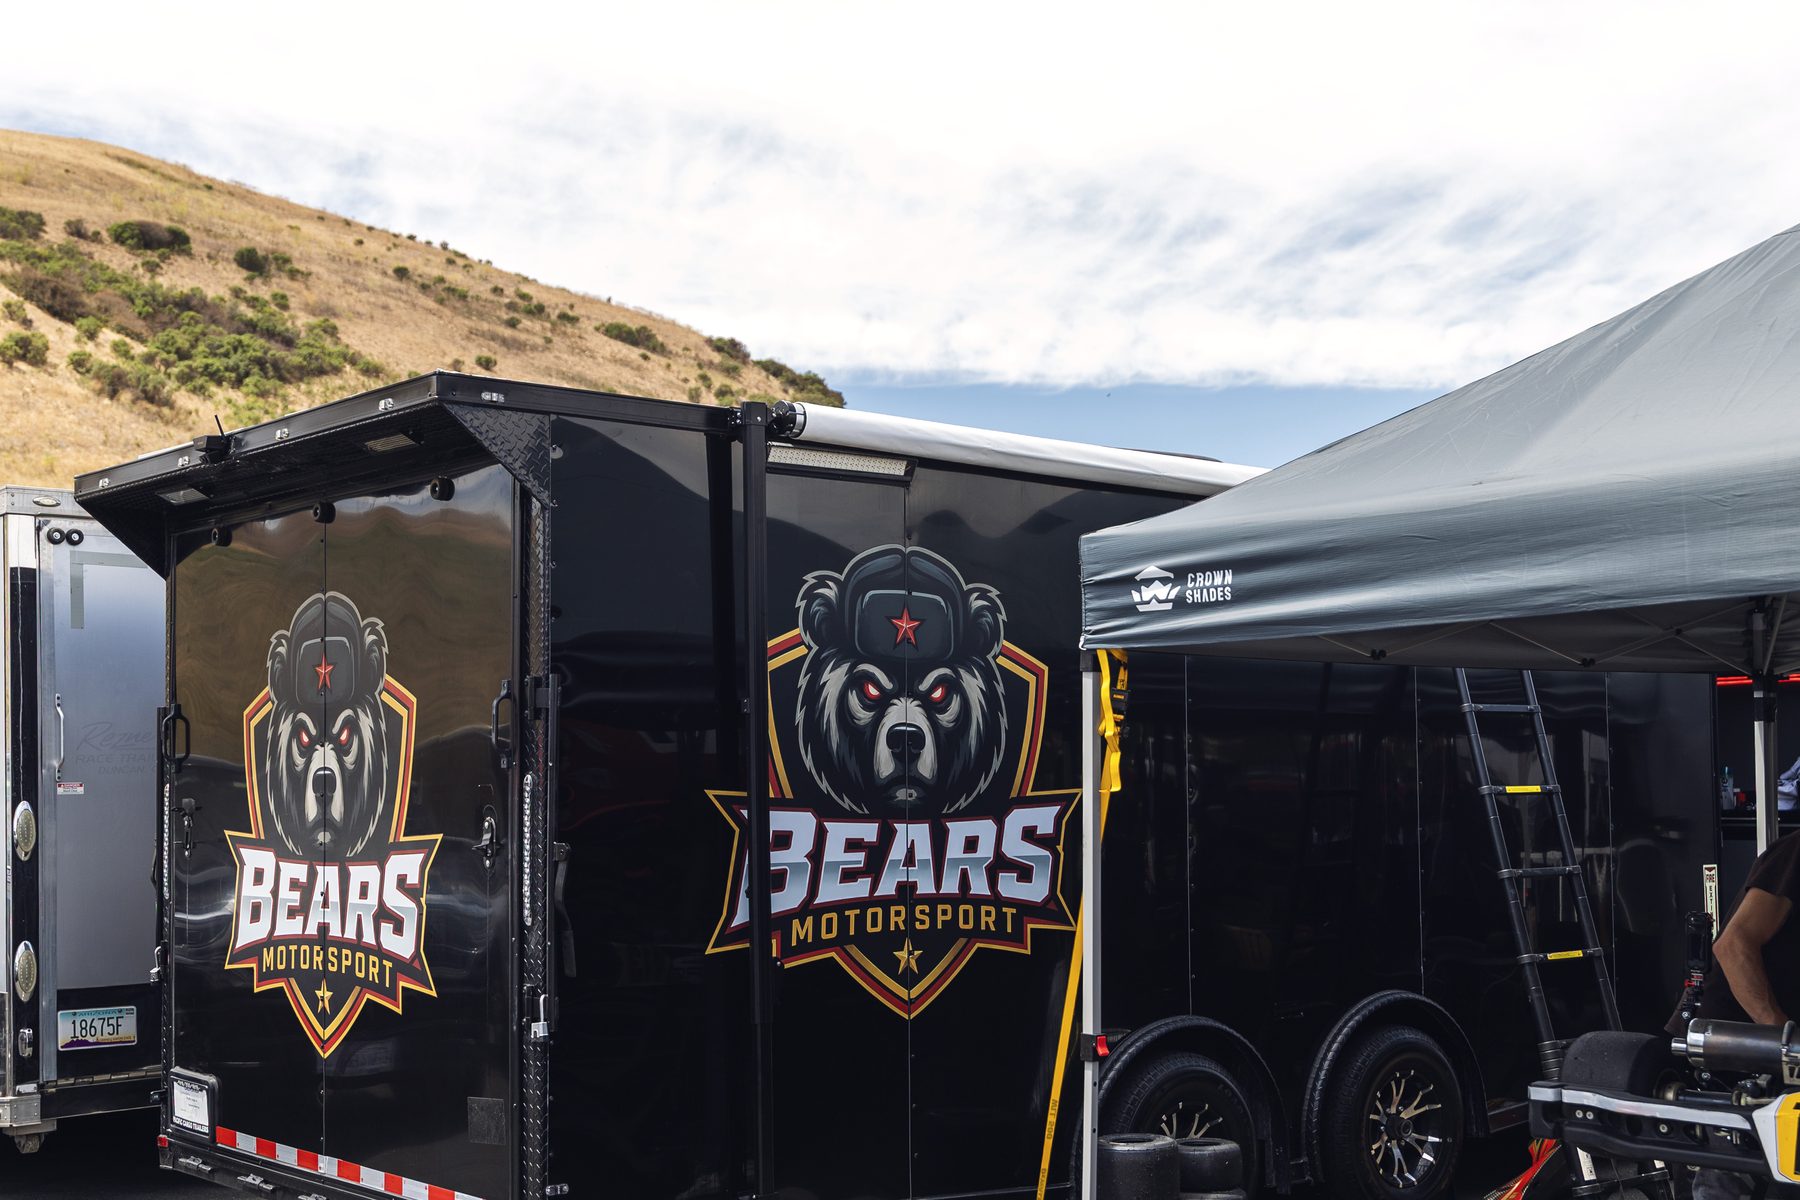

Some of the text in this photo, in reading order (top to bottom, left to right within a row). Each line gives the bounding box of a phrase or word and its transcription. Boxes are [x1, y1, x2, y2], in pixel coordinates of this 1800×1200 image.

[1185, 586, 1232, 604] SHADES
[1187, 569, 1233, 588] CROWN
[728, 803, 1065, 931] BEARS
[234, 847, 426, 960] BEARS
[791, 903, 1017, 947] MOTORSPORT
[262, 944, 393, 988] MOTORSPORT
[70, 1016, 124, 1039] 18675F
